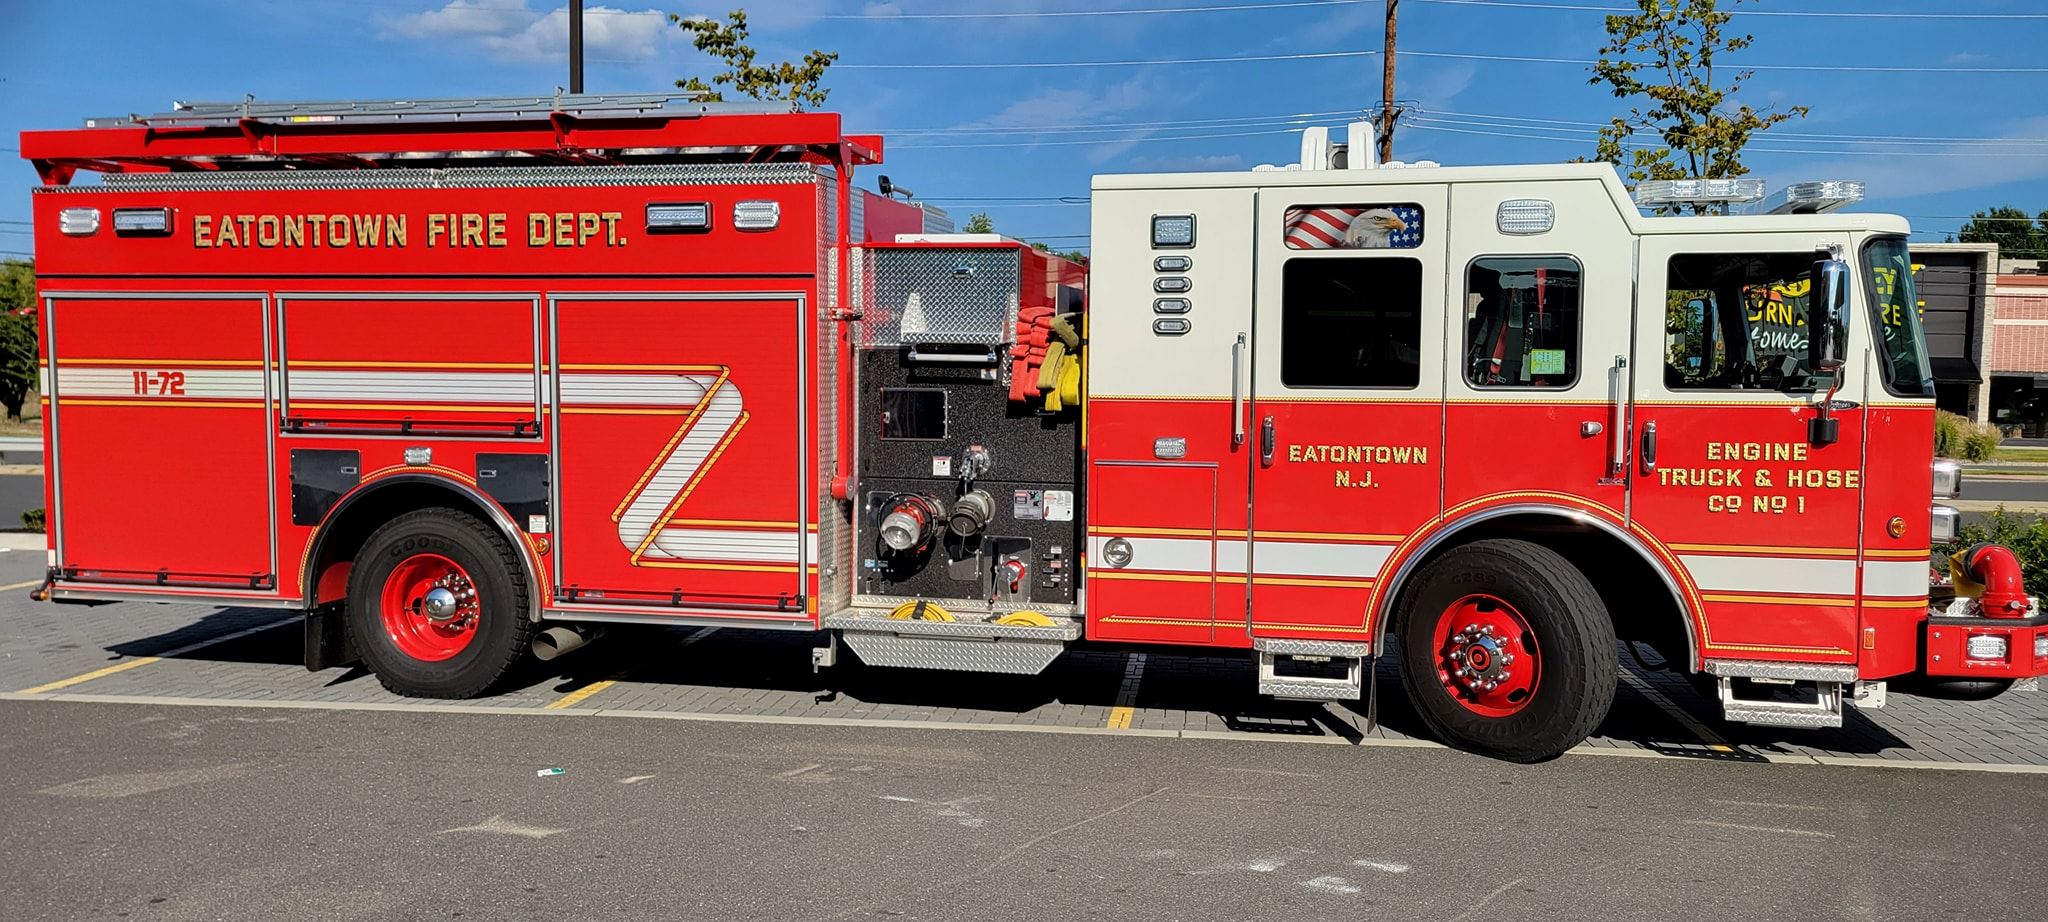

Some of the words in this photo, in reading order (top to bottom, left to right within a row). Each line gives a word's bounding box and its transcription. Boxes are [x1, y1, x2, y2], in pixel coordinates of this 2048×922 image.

[195, 214, 408, 248] EATONTOWN
[428, 213, 508, 247] FIRE
[529, 211, 628, 247] DEPT.
[133, 371, 186, 396] 11-72
[1289, 444, 1429, 465] EATONTOWN
[1707, 442, 1809, 462] ENGINE
[1335, 469, 1379, 489] N.J.
[1657, 467, 1743, 488] TRUCK
[1754, 468, 1774, 488] &
[1787, 469, 1860, 490] HOSE
[1797, 495, 1805, 514] 1
